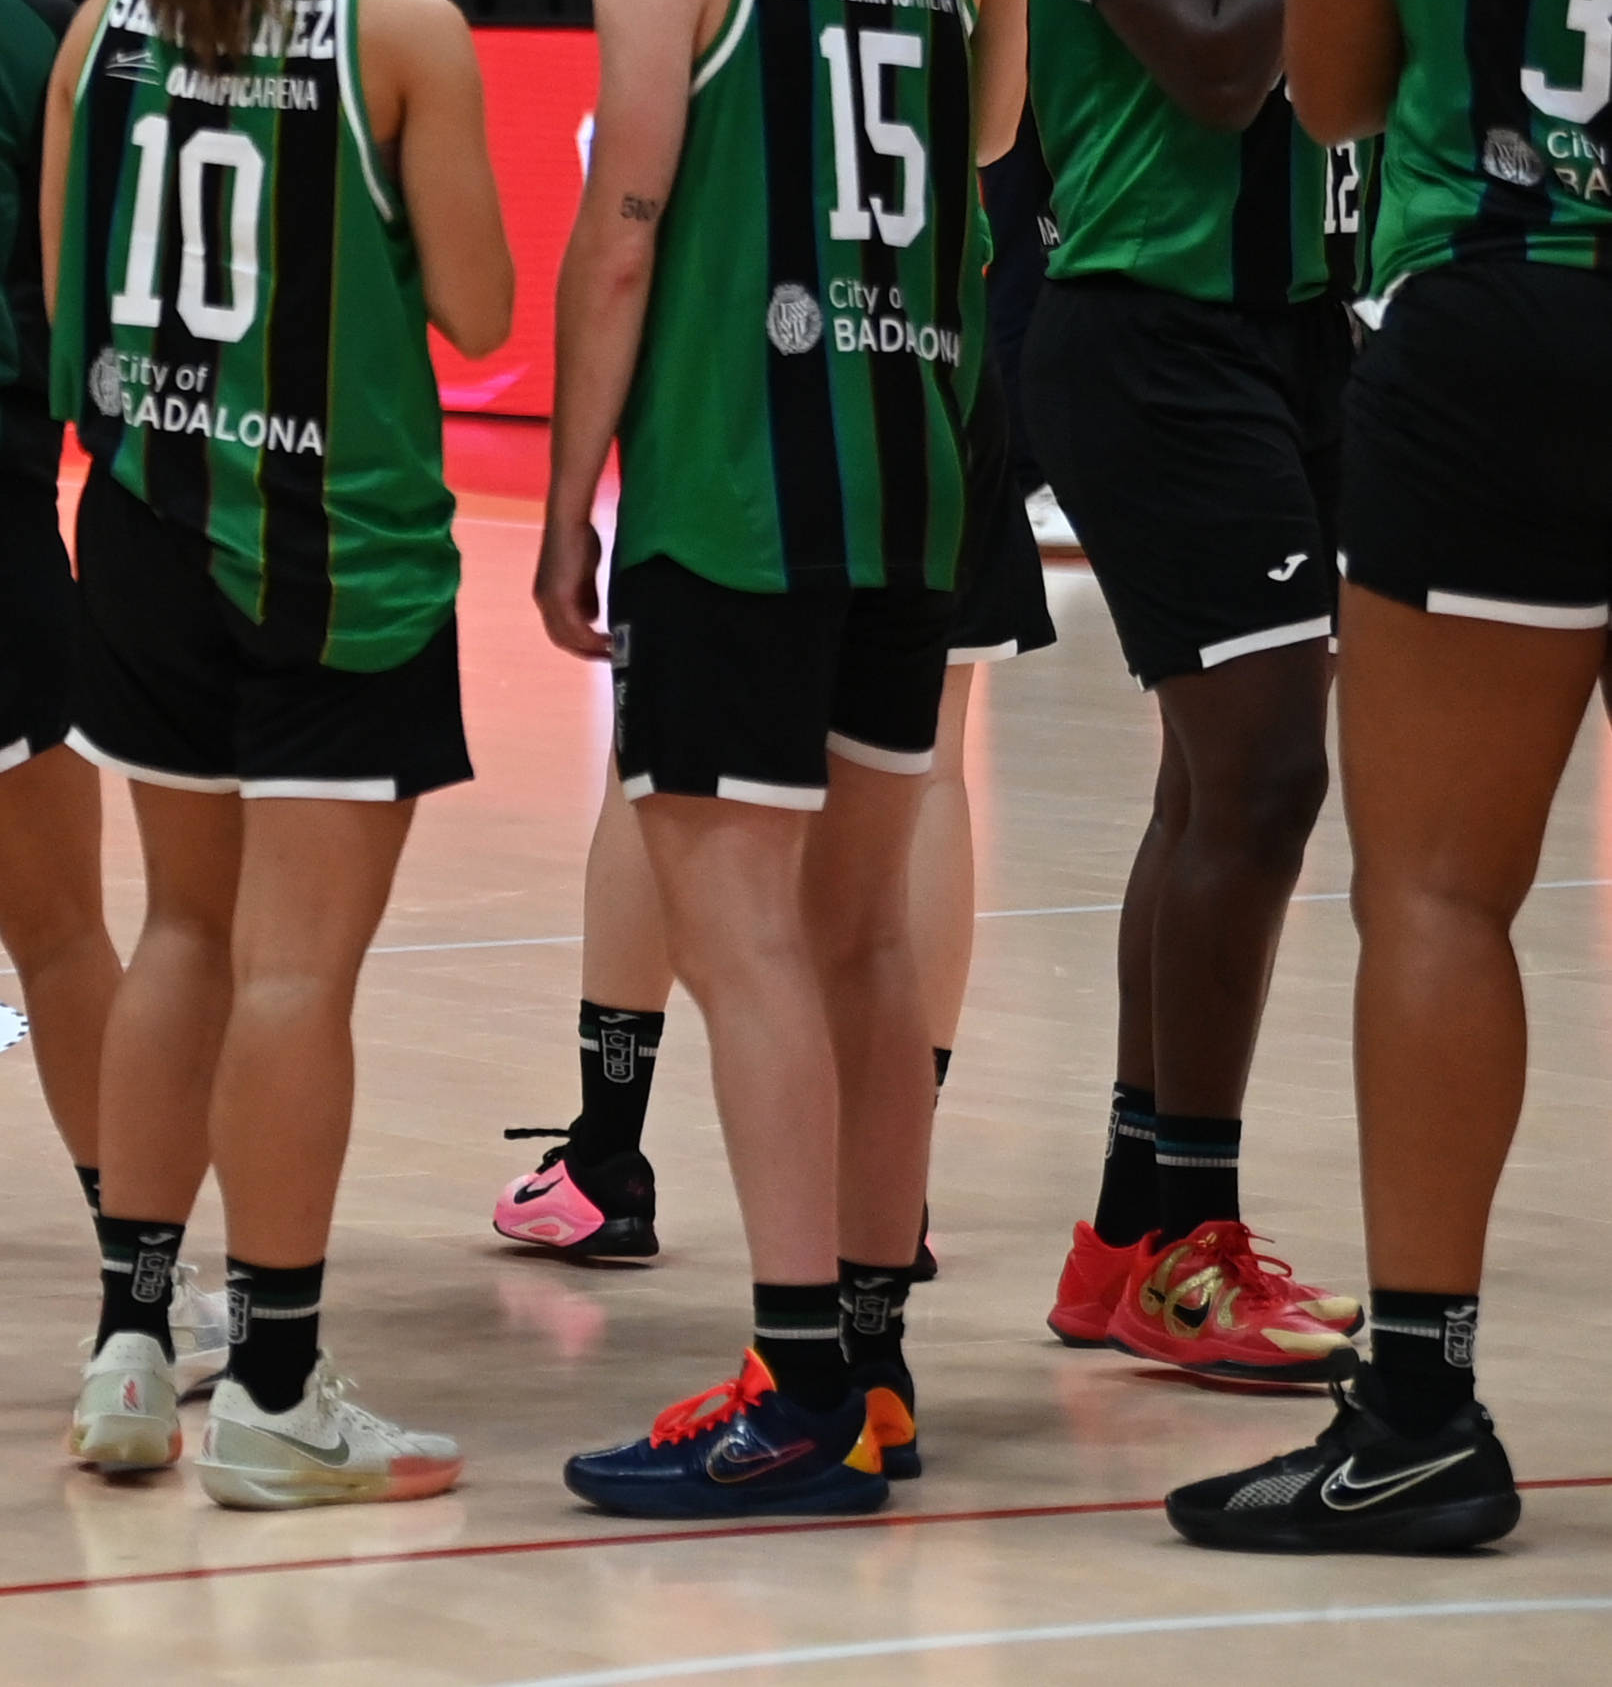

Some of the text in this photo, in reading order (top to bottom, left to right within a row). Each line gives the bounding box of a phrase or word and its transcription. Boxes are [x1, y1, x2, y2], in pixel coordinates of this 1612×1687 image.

[819, 26, 926, 248] 15
[111, 115, 265, 343] 10
[1324, 138, 1360, 235] 12
[829, 280, 880, 315] City
[176, 364, 209, 393] of
